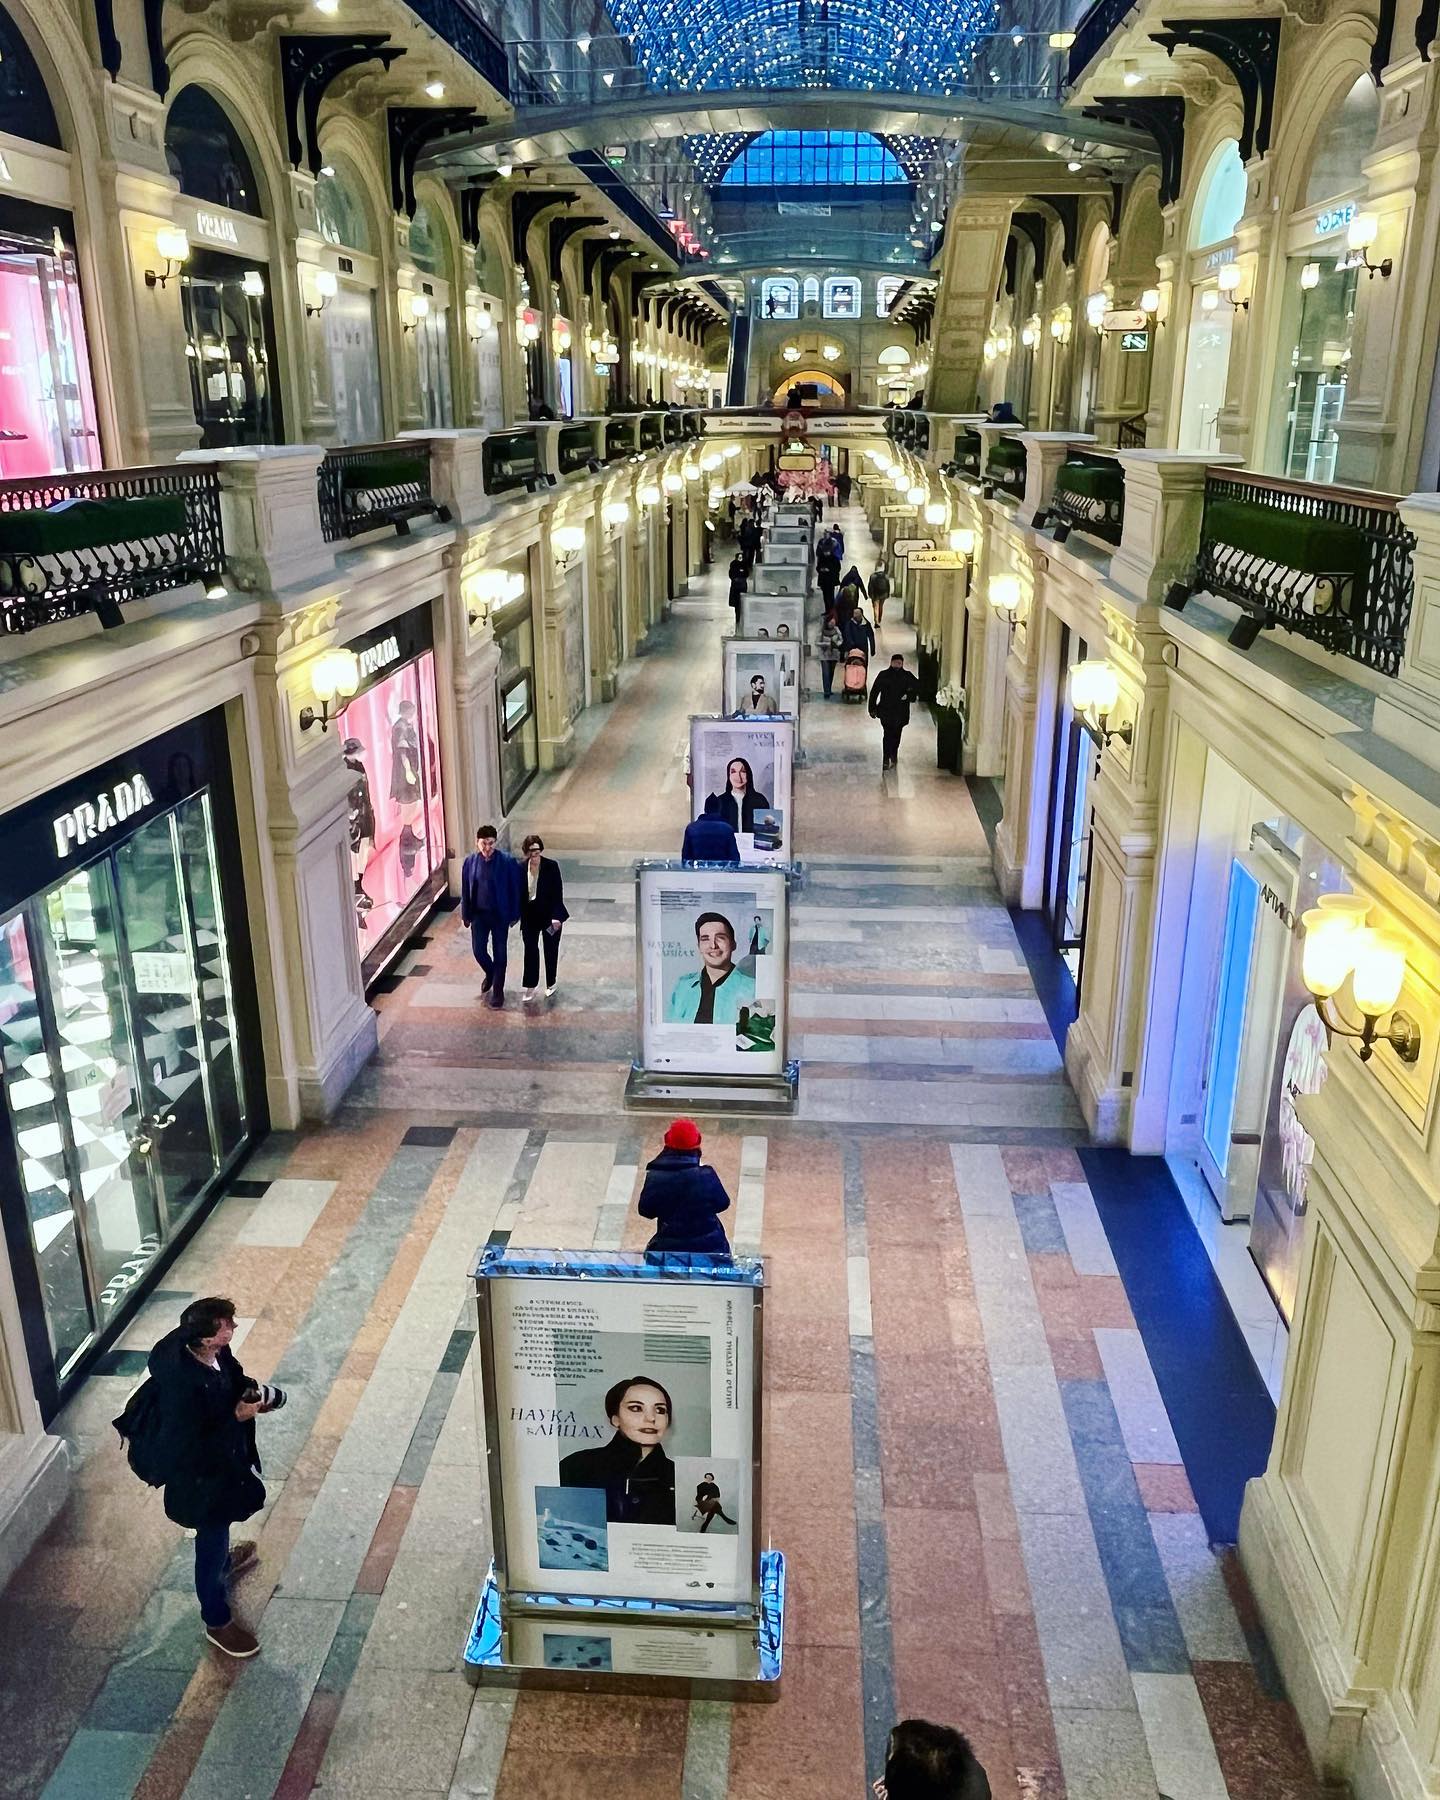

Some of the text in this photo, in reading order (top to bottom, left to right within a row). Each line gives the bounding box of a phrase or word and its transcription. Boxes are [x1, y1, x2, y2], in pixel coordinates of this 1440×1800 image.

[196, 211, 238, 244] PRADA
[359, 635, 400, 678] PRADA
[53, 773, 154, 858] PRADA
[510, 1406, 576, 1423] НАУКА
